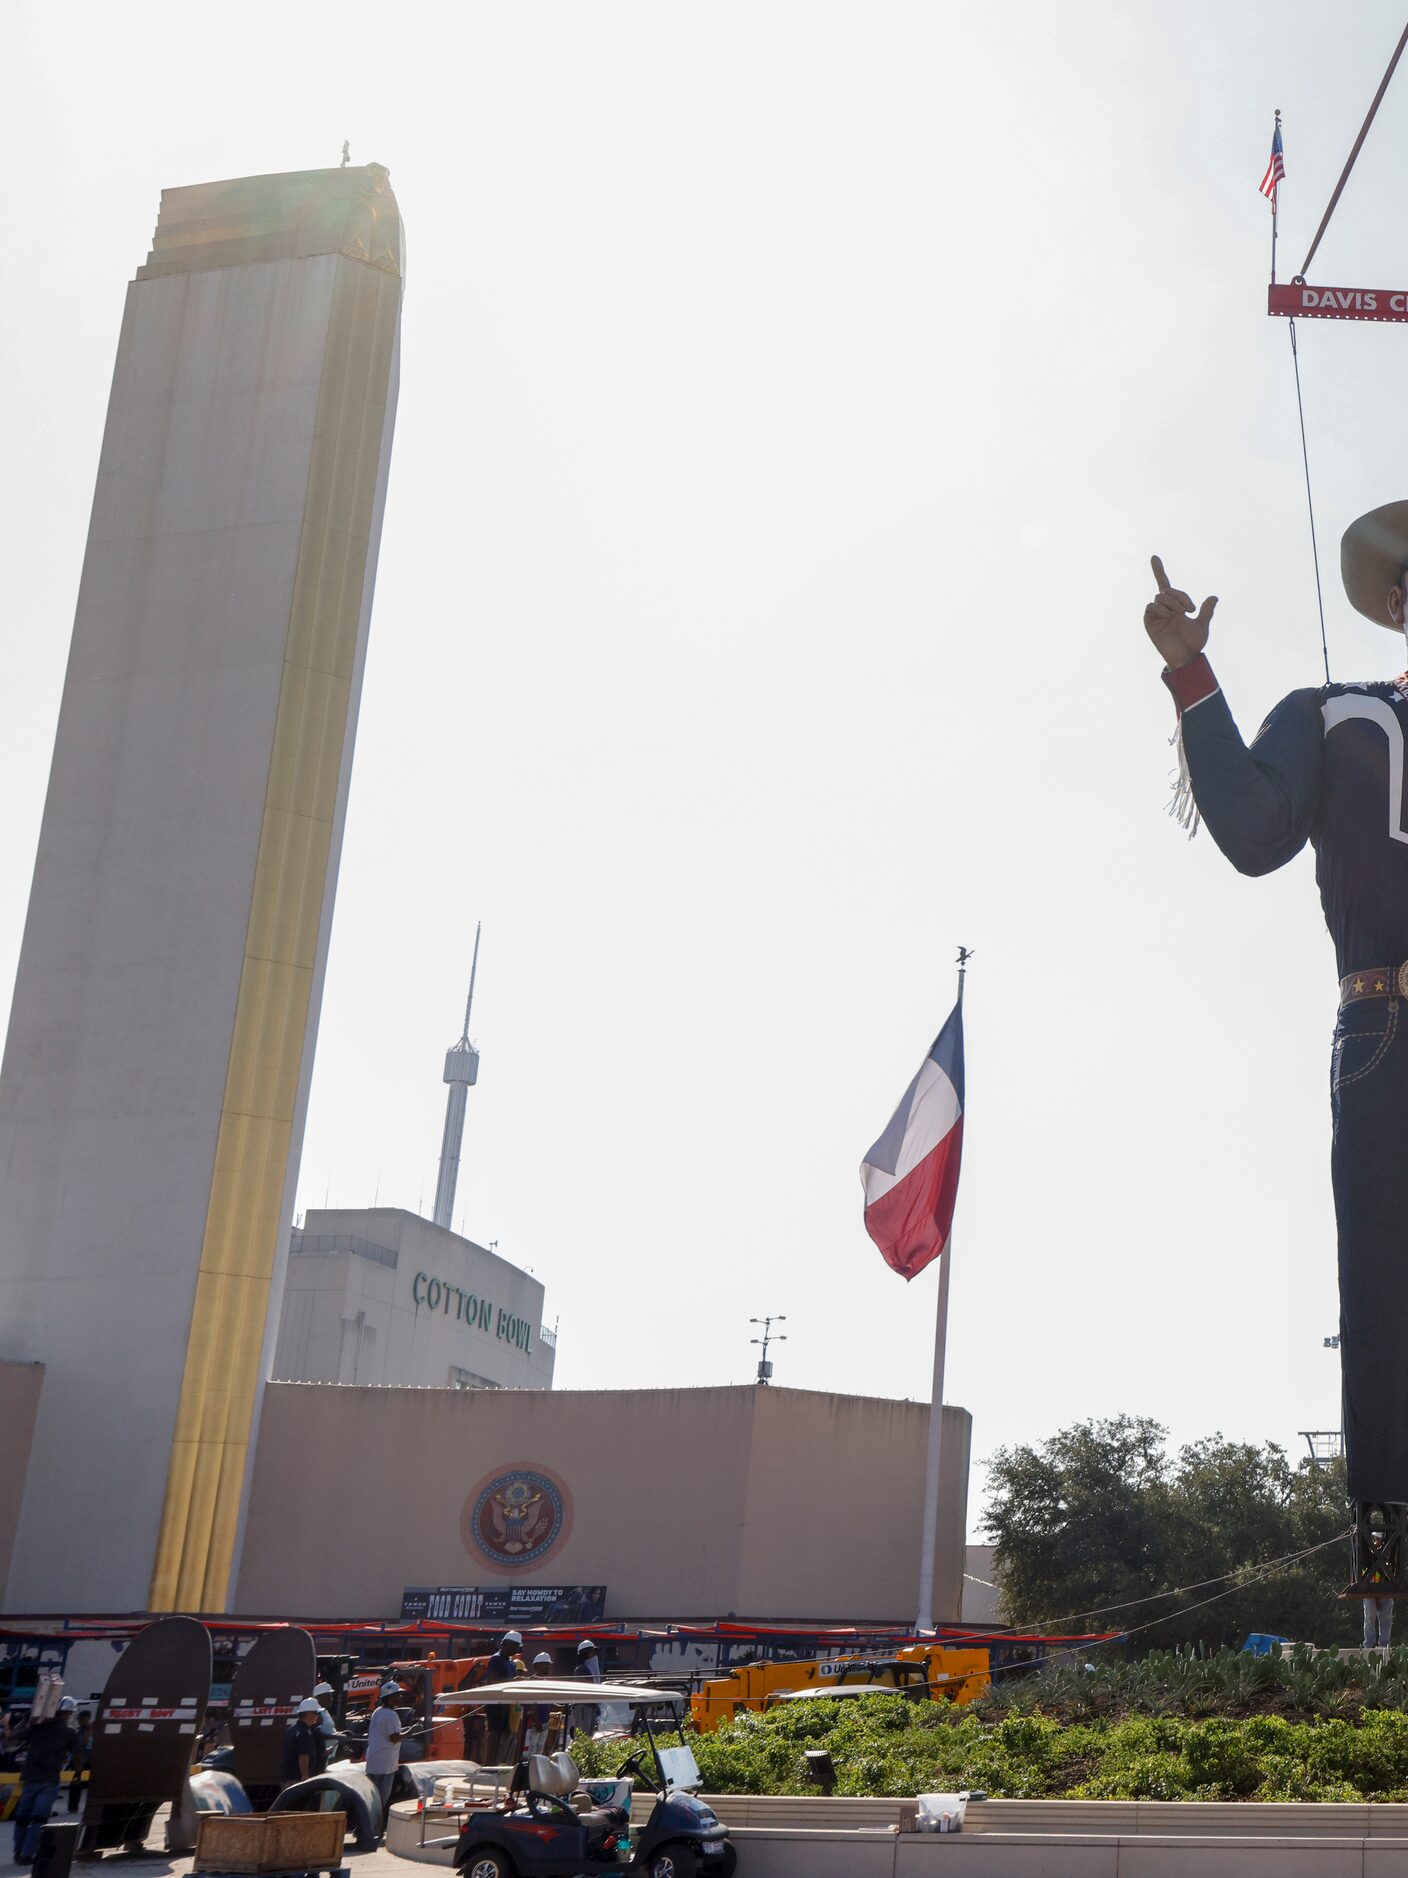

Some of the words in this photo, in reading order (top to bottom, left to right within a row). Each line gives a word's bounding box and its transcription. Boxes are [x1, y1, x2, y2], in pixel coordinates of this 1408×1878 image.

[1302, 290, 1377, 311] DAVIS
[413, 1271, 493, 1333] COTTON
[496, 1308, 532, 1354] BOWL
[427, 1594, 452, 1618] FOOD
[453, 1594, 484, 1618] COURT
